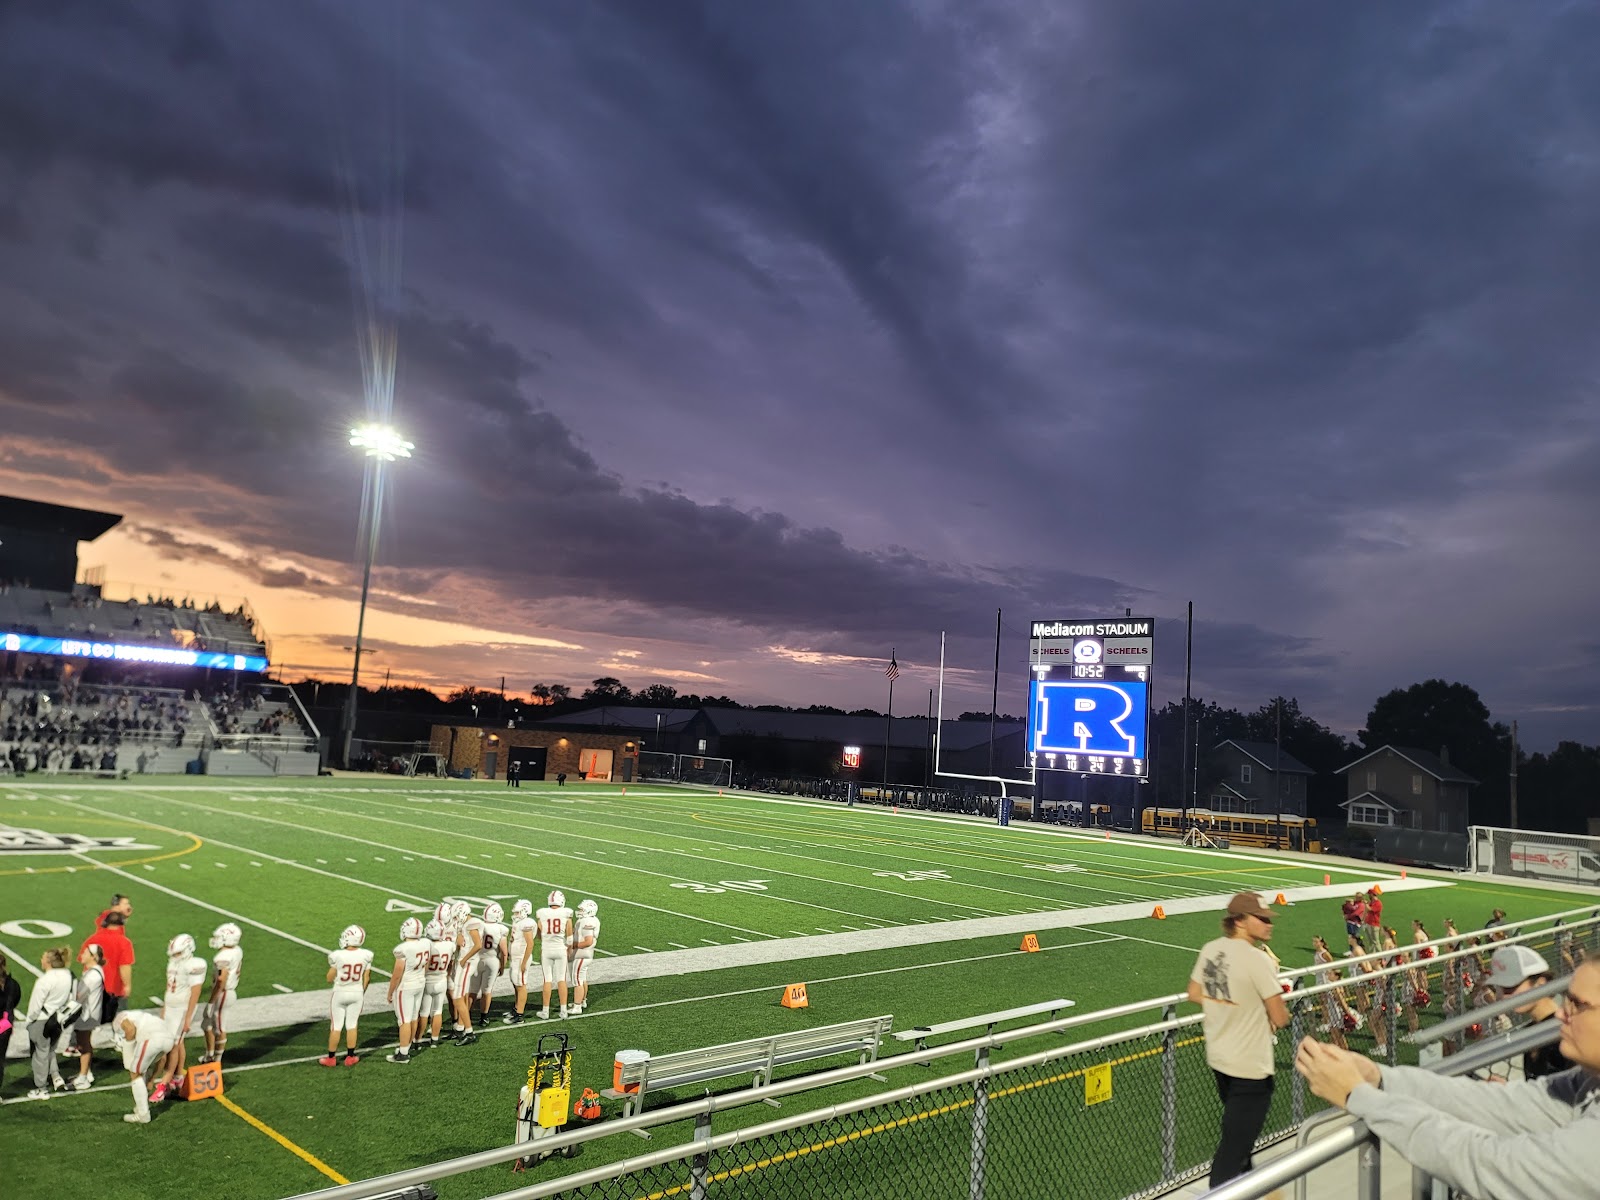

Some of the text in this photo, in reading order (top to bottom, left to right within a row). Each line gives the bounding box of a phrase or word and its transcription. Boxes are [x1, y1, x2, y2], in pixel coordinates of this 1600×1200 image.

[1033, 623, 1148, 637] Mediacom STADIUM
[1106, 647, 1148, 655] SCHEELS
[1074, 665, 1104, 678] 10:52
[1138, 671, 1146, 682] 9
[1036, 682, 1135, 757] R
[845, 754, 857, 766] 40
[546, 918, 561, 935] 18
[1027, 937, 1037, 949] 30
[428, 953, 449, 971] 53
[340, 963, 363, 982] 39
[791, 987, 805, 1001] 40
[193, 1069, 219, 1095] 50
